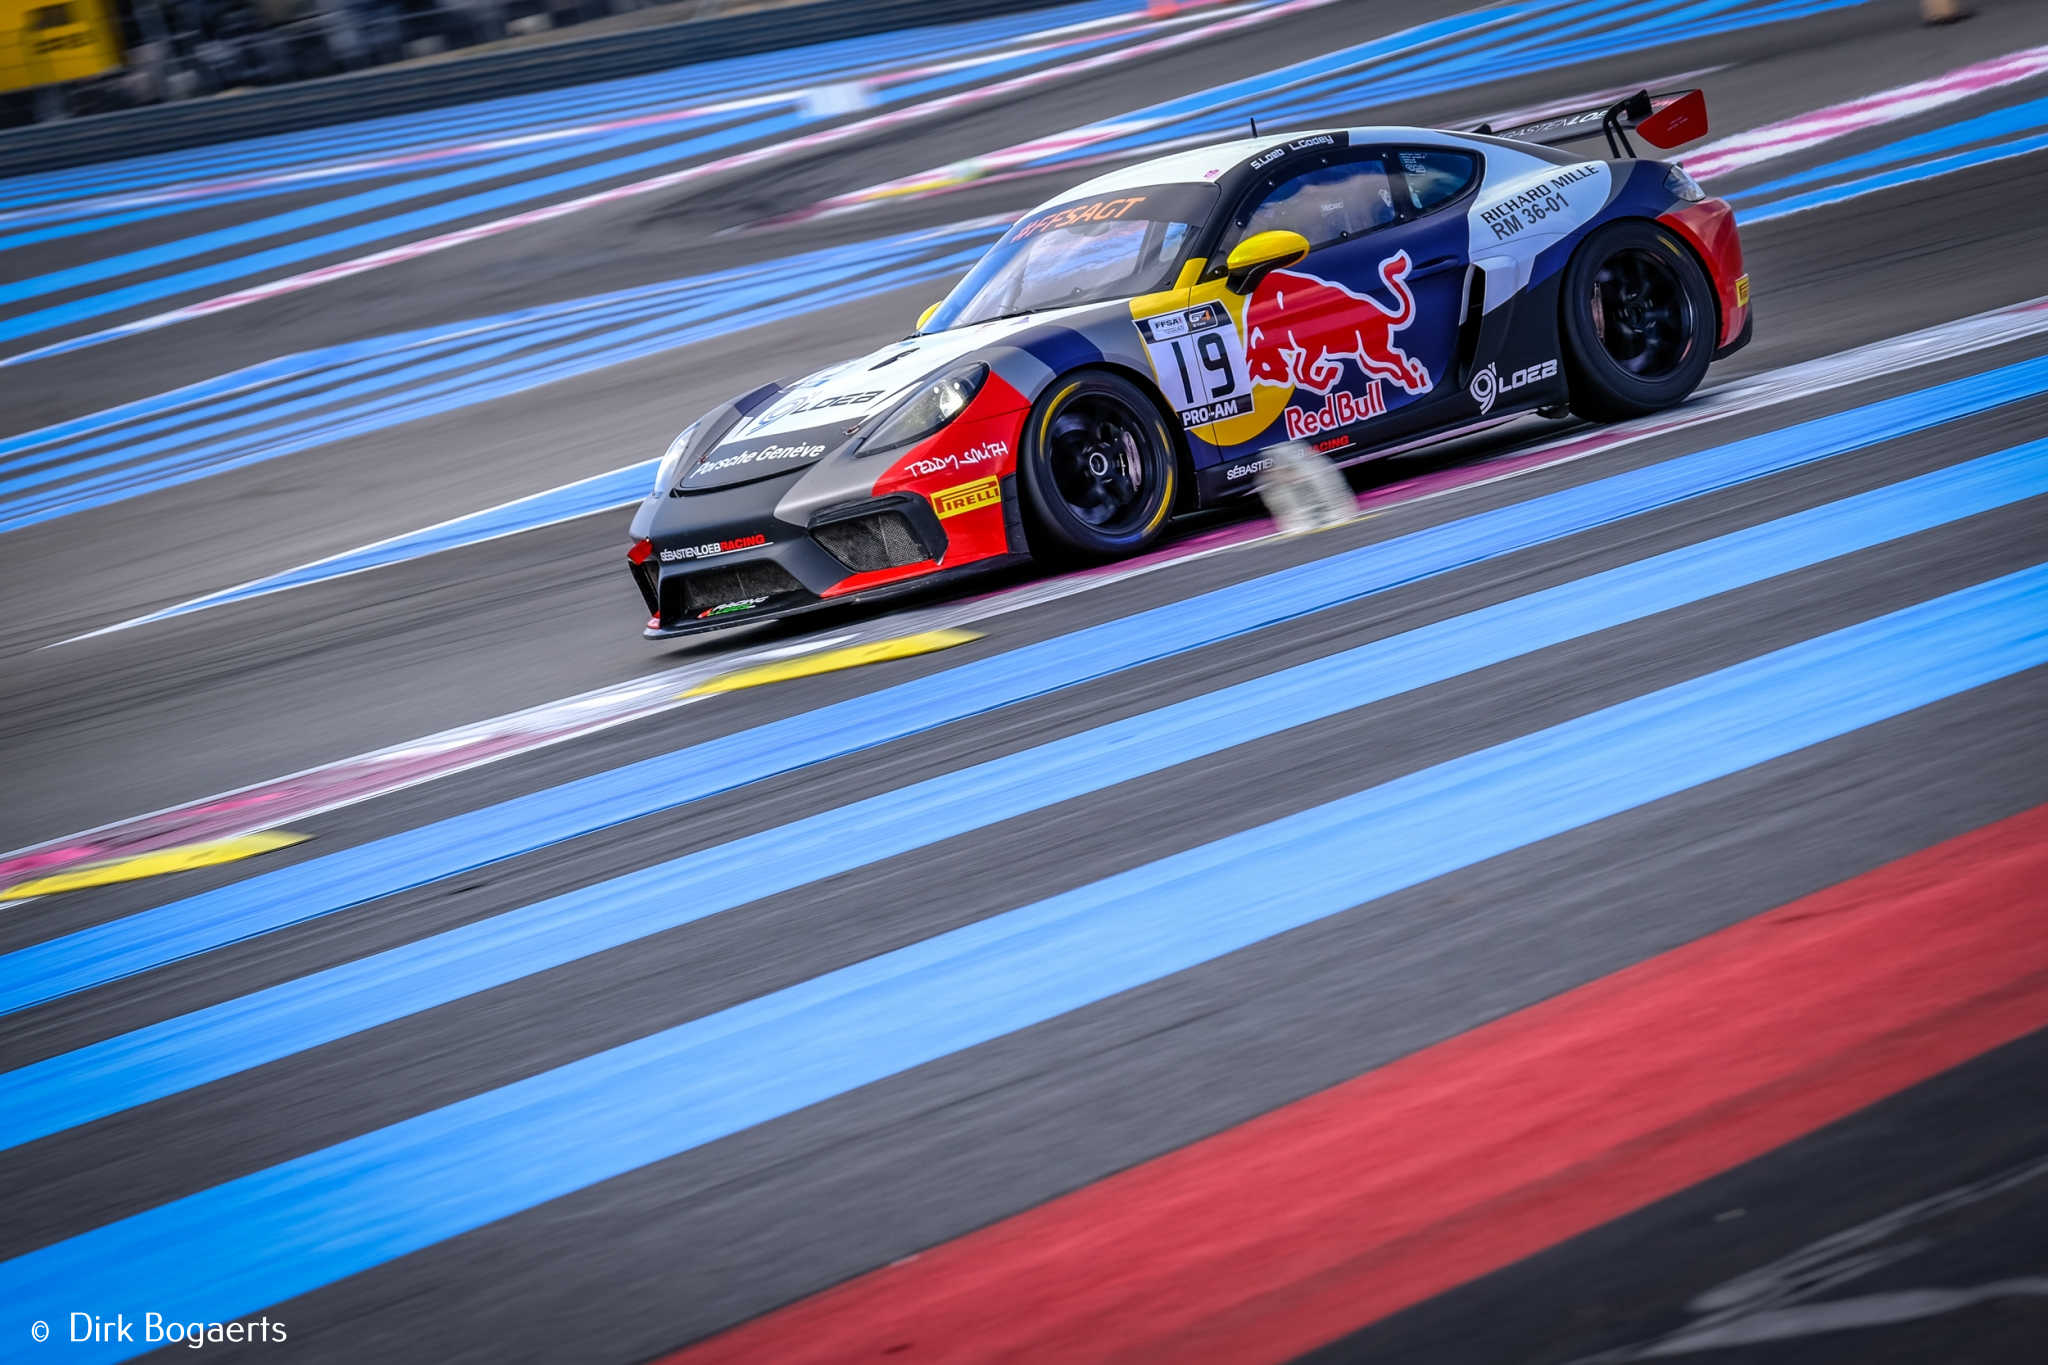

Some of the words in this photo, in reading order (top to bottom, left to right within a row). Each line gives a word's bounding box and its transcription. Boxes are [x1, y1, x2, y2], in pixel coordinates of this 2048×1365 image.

[1480, 184, 1551, 224] RICHARD
[1551, 164, 1599, 189] MILLE
[1491, 215, 1524, 240] RM
[1522, 192, 1569, 224] 36-01
[1171, 332, 1235, 404] 19
[1499, 359, 1557, 393] LOEB
[1182, 400, 1238, 426] PRO-AM
[1285, 394, 1338, 440] Red
[1335, 380, 1387, 427] Bull
[904, 454, 959, 478] TEDDY
[933, 480, 1000, 514] PIRELLI
